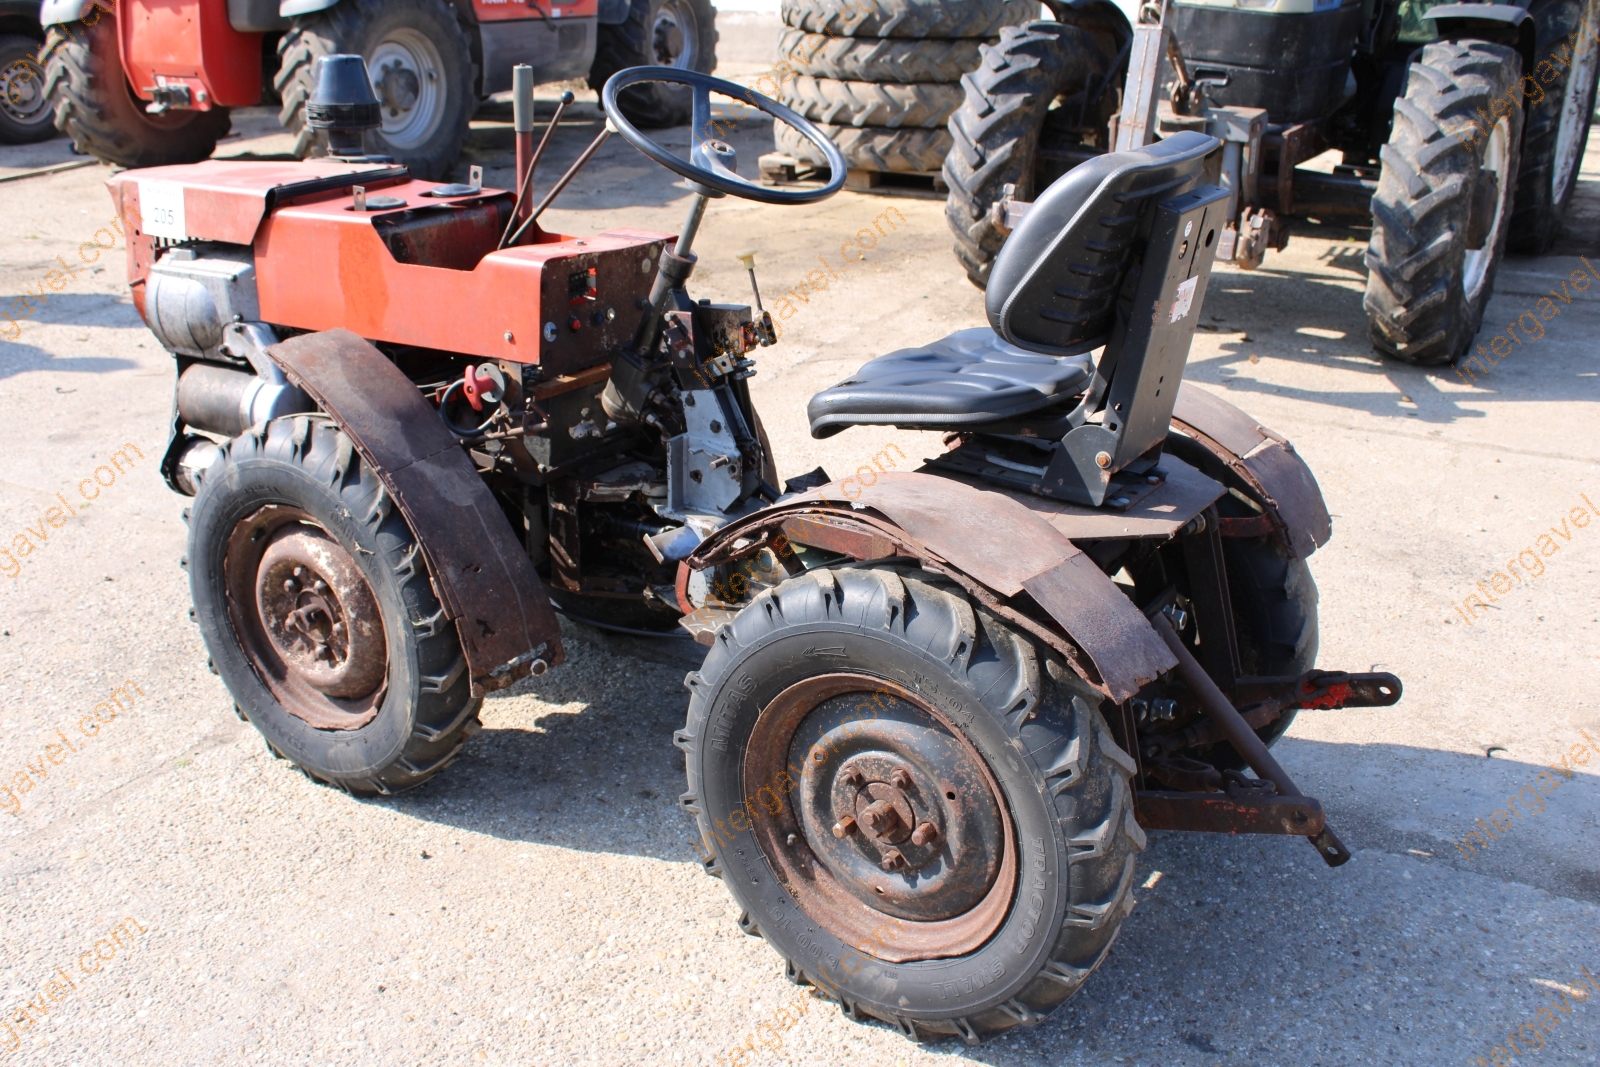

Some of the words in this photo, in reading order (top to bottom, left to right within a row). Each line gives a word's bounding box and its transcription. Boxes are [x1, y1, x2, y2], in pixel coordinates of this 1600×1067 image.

[154, 207, 174, 225] 205
[710, 672, 758, 752] MITAS
[1014, 838, 1047, 954] TRACTOR
[931, 957, 1007, 999] SMALL
